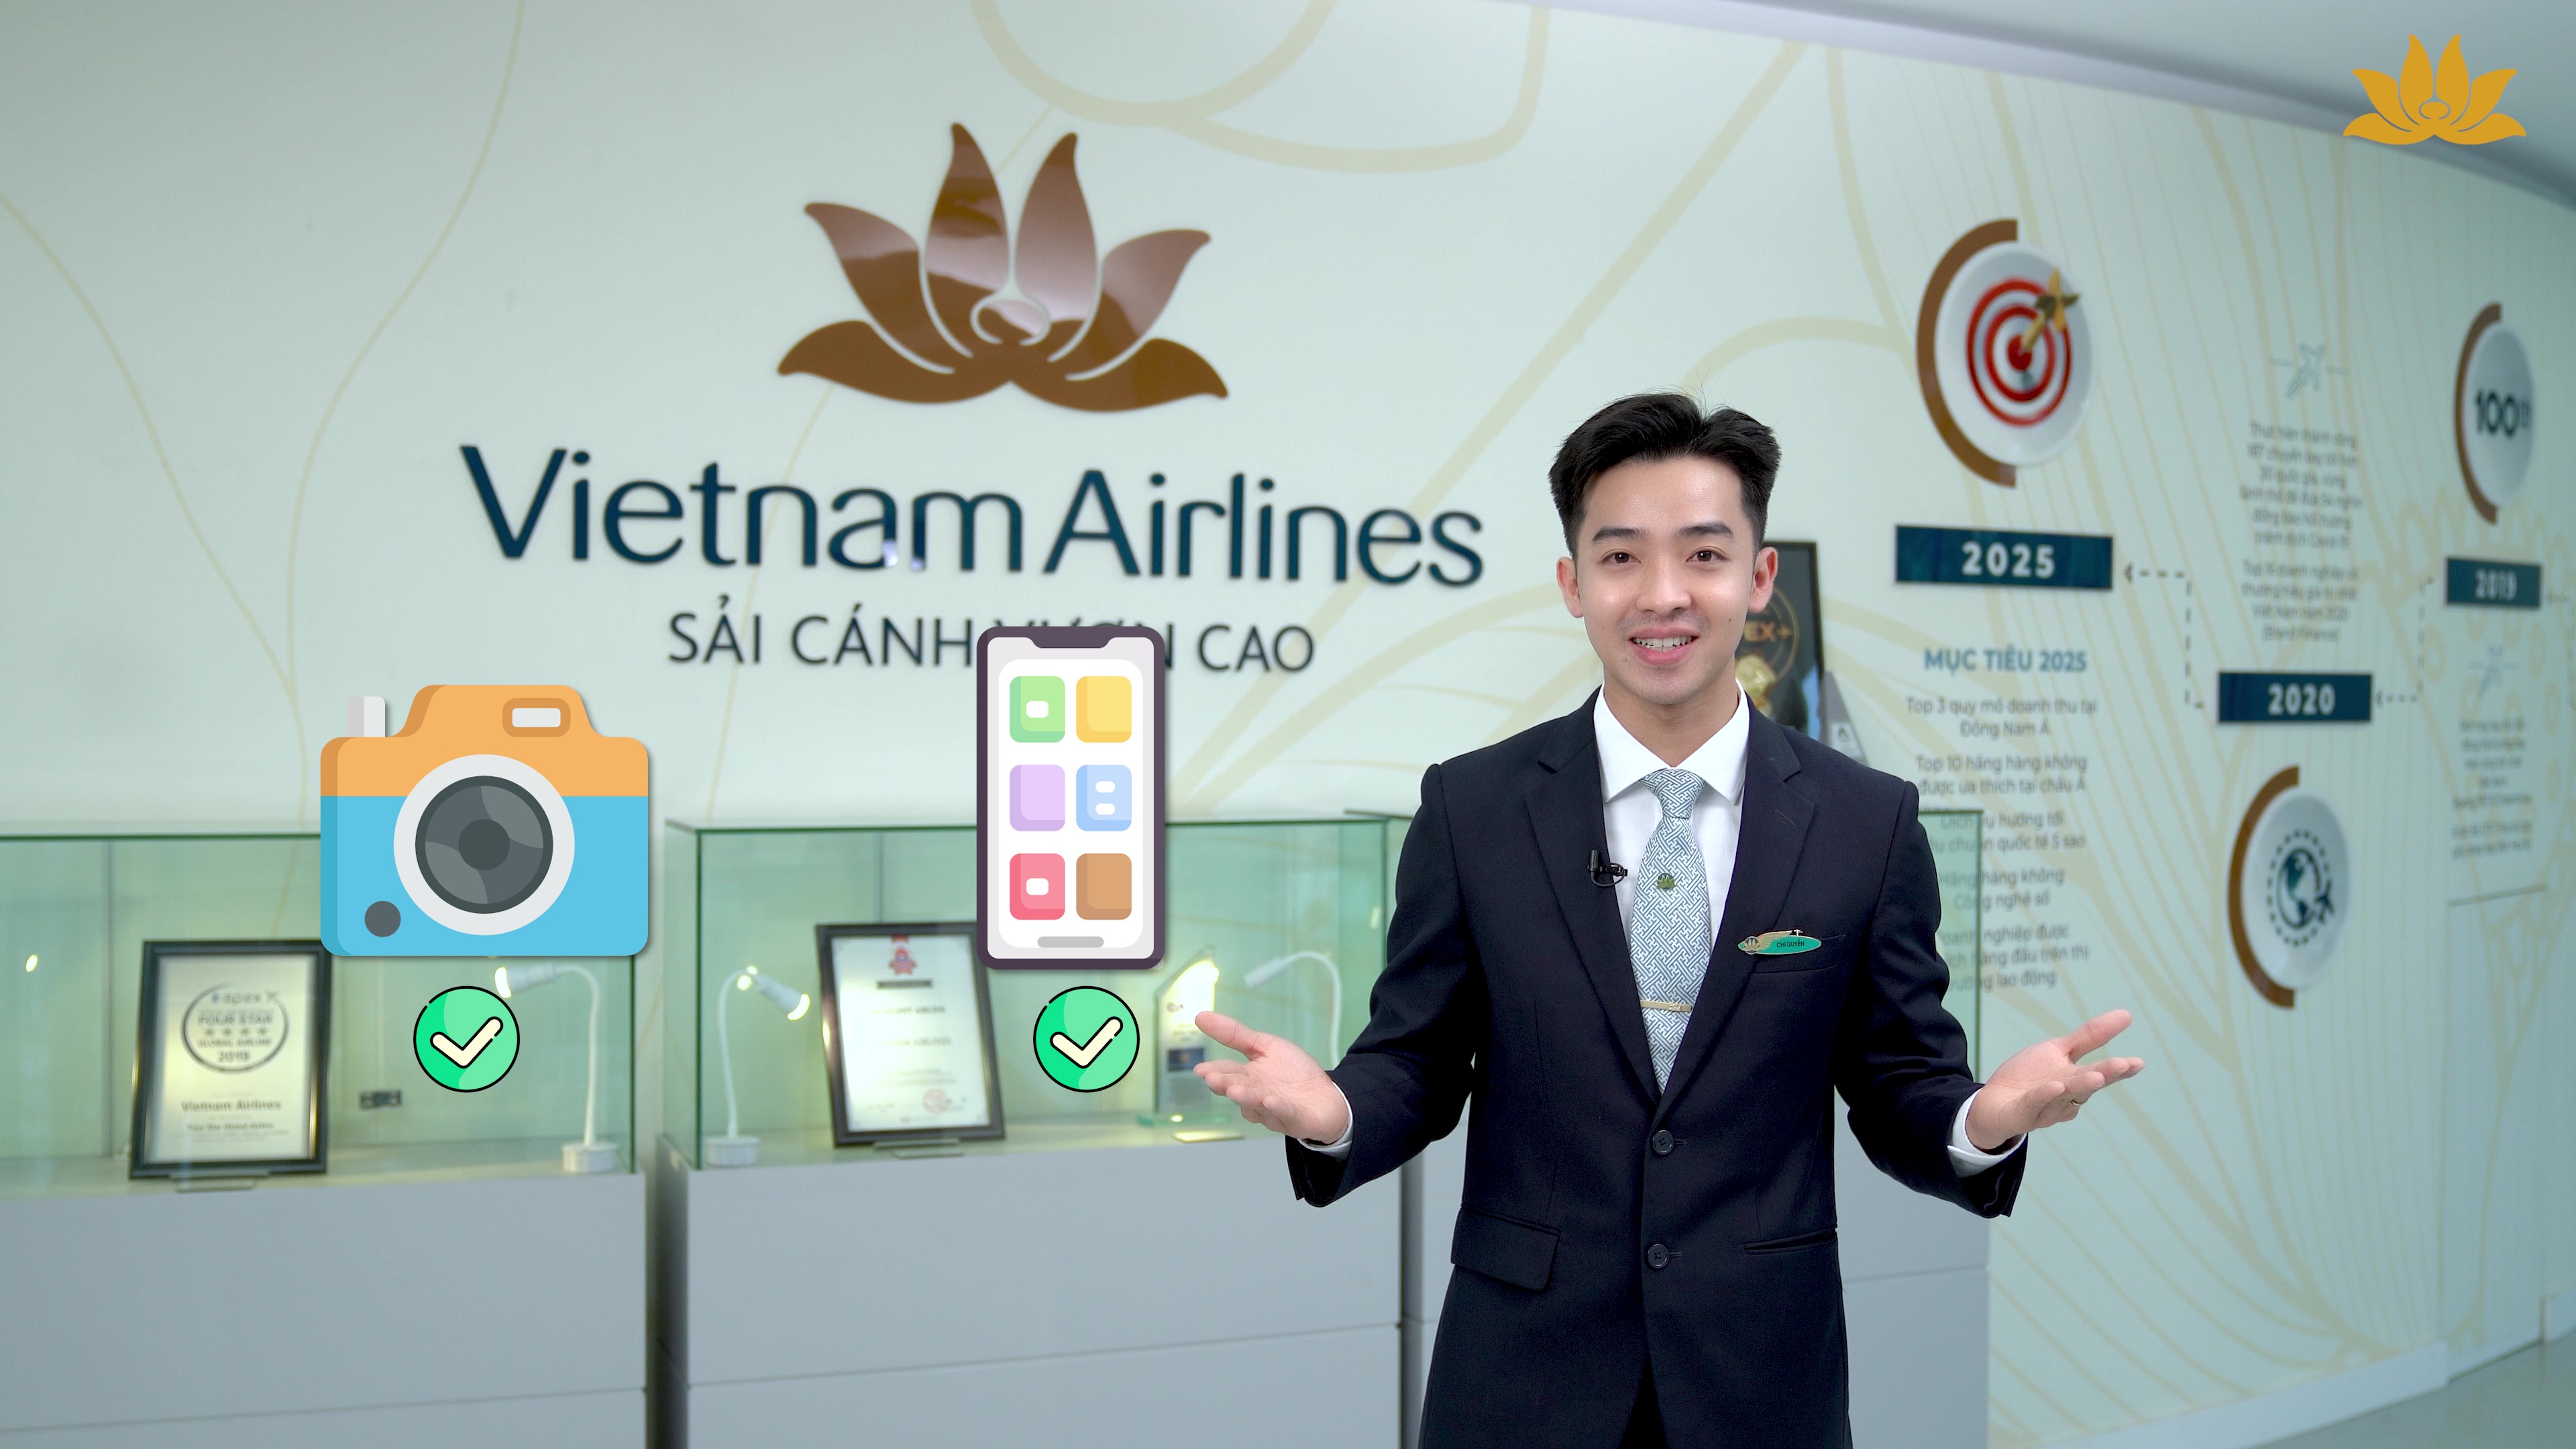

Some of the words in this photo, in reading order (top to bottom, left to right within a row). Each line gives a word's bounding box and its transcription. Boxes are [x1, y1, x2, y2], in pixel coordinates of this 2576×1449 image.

[460, 443, 1025, 573] Vietnam
[1042, 469, 1485, 588] Airlines
[1961, 541, 2056, 579] 2025
[669, 594, 763, 666] SẢI
[790, 597, 973, 669] CÁNH
[1197, 623, 1316, 673] CAO
[1923, 647, 1977, 676] MỤC
[1984, 643, 2032, 671] TIÊU
[2039, 649, 2087, 672] 2025
[1906, 696, 1933, 716] Top
[1937, 697, 1945, 713] 3
[1949, 700, 1976, 718] quy
[2267, 683, 2336, 716] 2020
[2002, 720, 2035, 736] Nam
[1917, 755, 1942, 774] Top
[1947, 755, 1962, 771] 10
